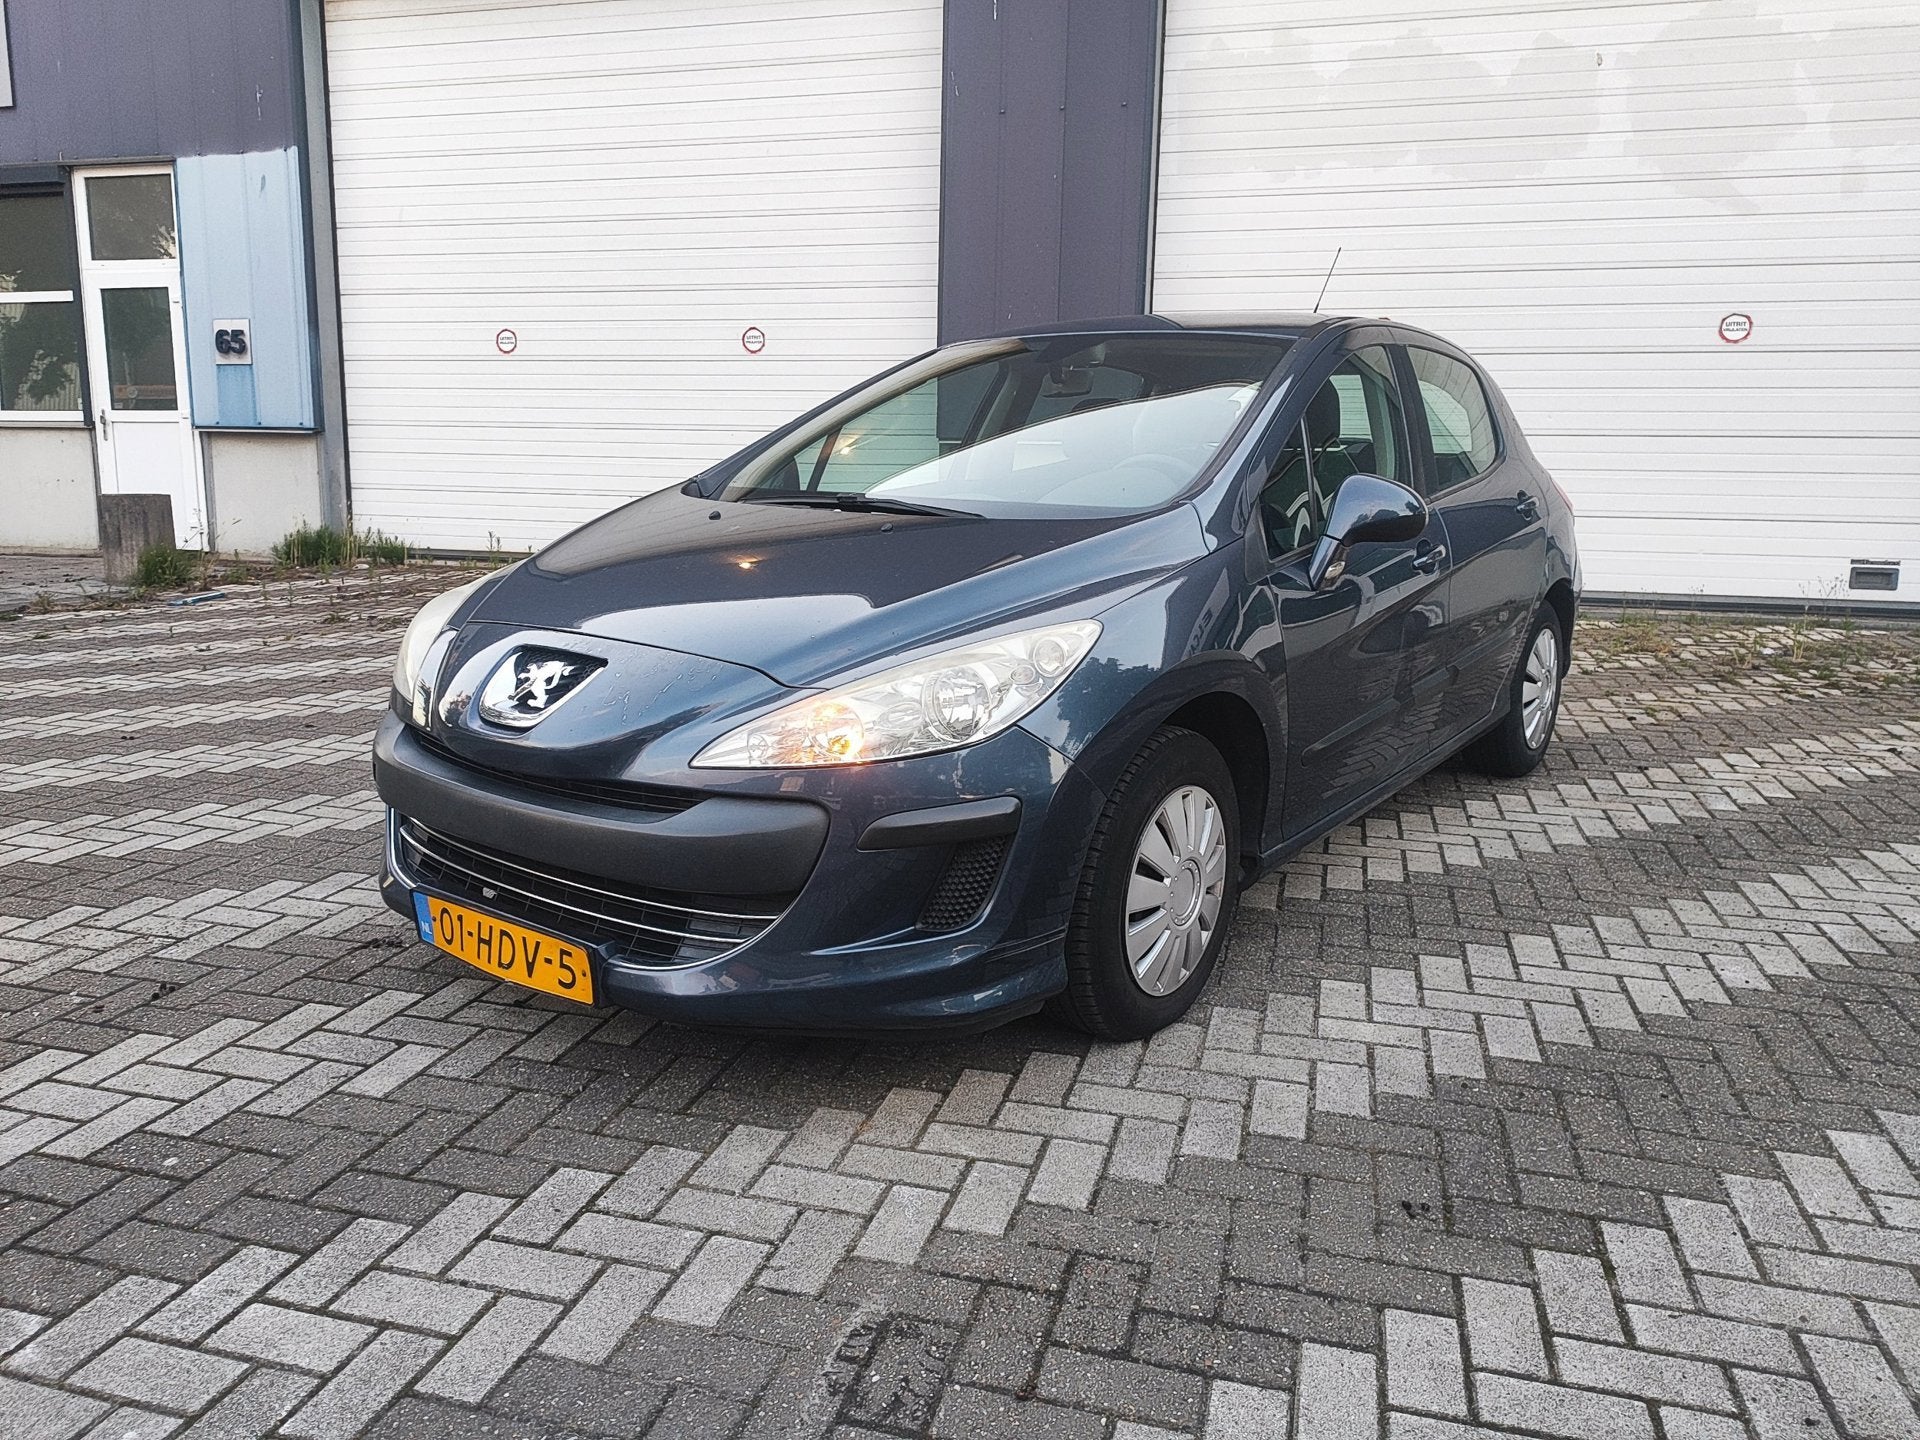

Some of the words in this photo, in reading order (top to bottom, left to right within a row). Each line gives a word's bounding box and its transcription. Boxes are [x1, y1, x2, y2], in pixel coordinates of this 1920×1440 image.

[215, 329, 247, 354] 65
[421, 920, 433, 935] NL
[439, 907, 577, 990] 01-HDV-5
